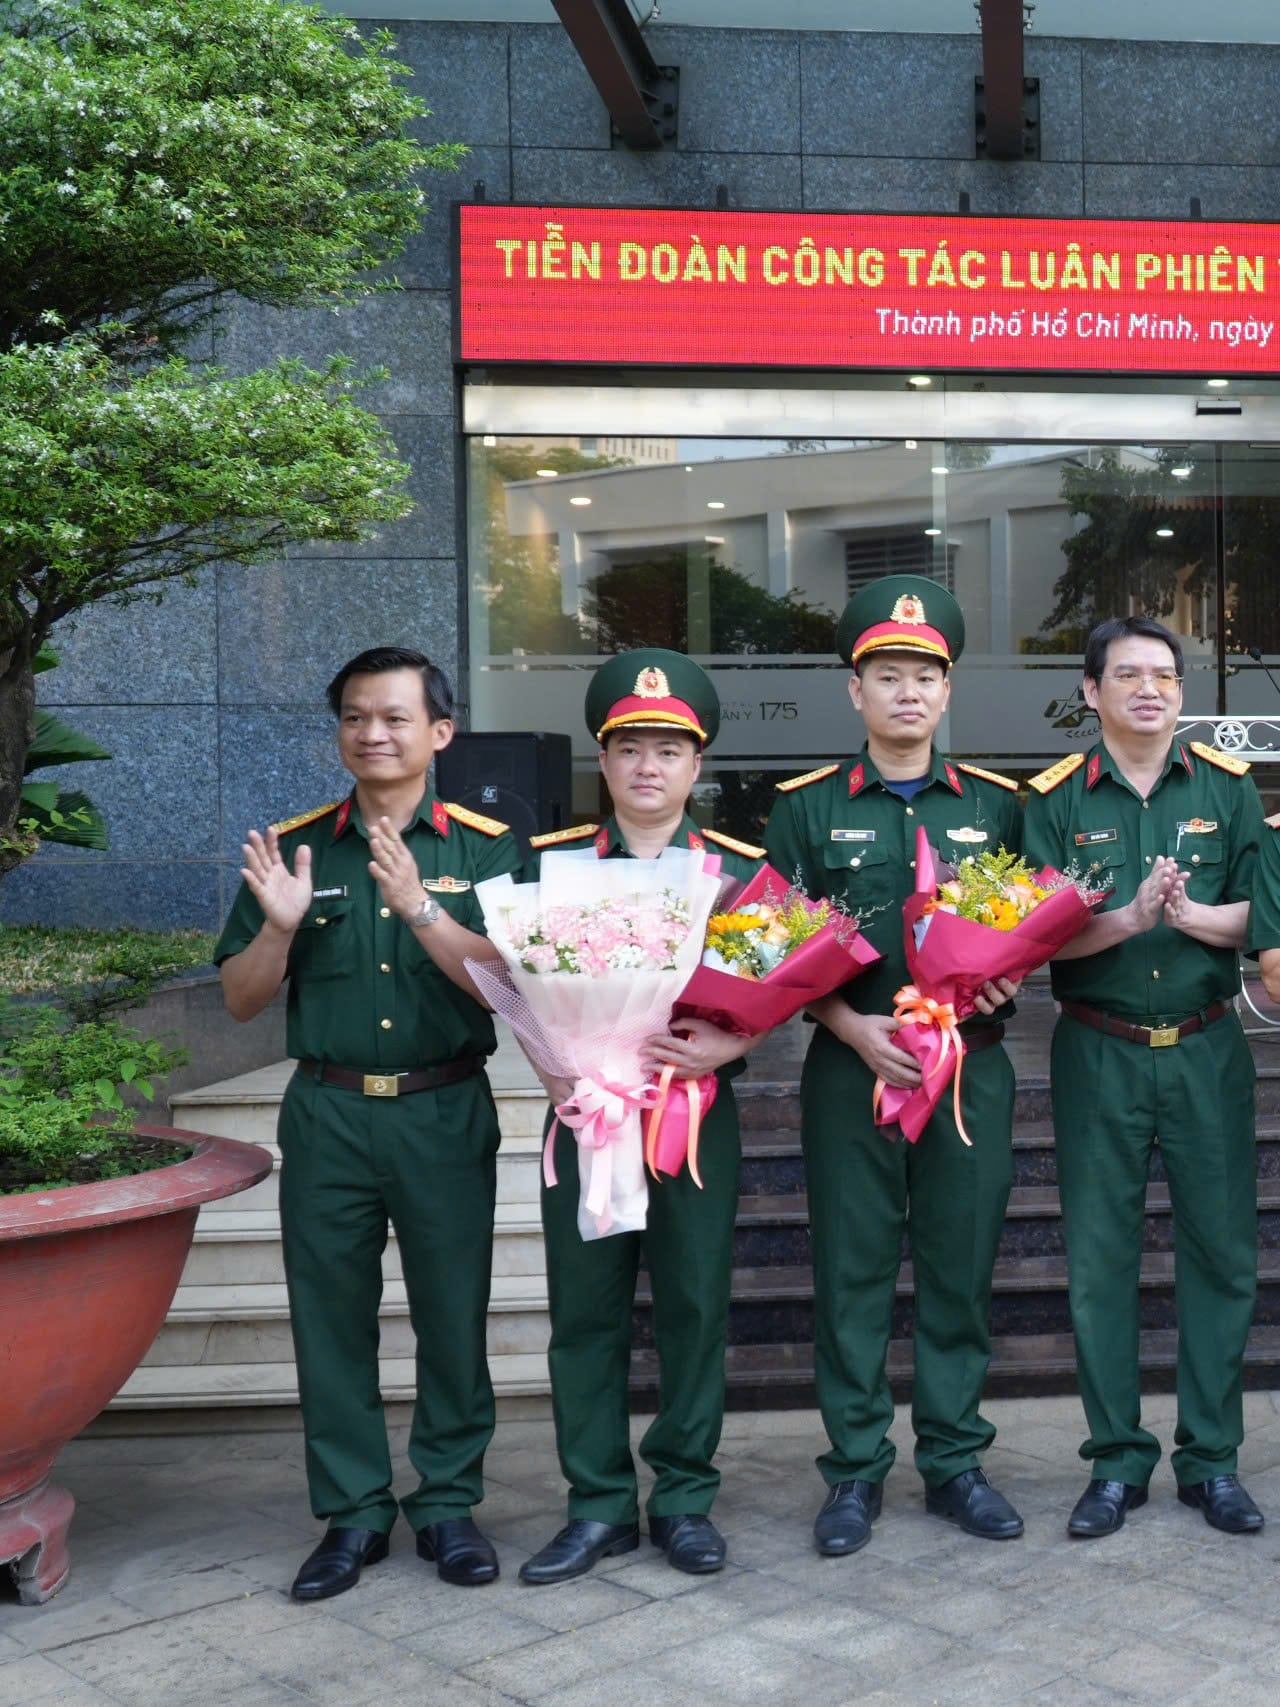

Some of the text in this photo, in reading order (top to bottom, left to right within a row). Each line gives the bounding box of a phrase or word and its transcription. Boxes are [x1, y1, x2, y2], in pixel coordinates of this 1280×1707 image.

[496, 221, 602, 279] TIỄN
[617, 234, 747, 283] ĐOÀN
[762, 236, 885, 287] CÔNG
[899, 240, 987, 289] TÁC
[1000, 243, 1121, 290] LUÂN
[1134, 245, 1265, 292] PHIÊN
[875, 307, 962, 336] Thành
[969, 308, 1026, 343] phố
[1127, 312, 1200, 342] Minh,
[1208, 314, 1275, 347] ngày
[759, 701, 799, 721] 175
